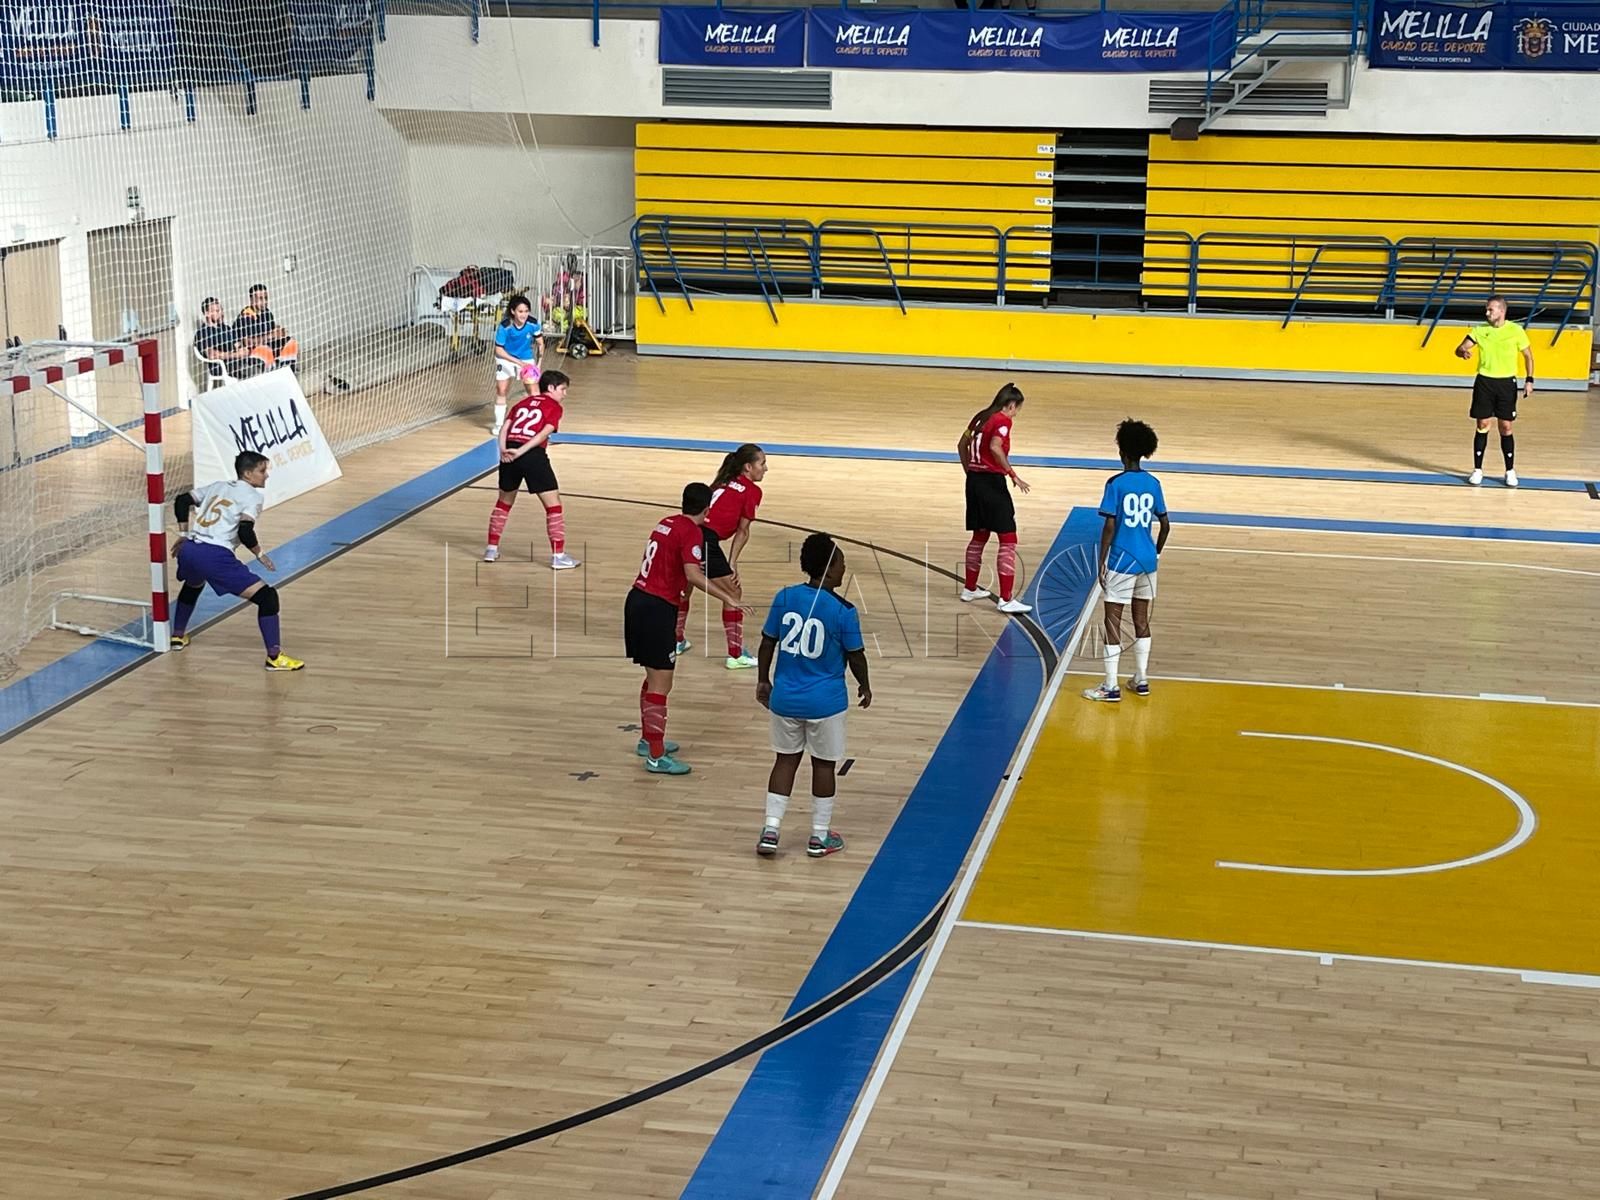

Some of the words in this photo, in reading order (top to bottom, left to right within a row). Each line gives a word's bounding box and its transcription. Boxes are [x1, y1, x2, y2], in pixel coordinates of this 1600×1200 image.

[705, 23, 777, 44] MELILLA
[836, 24, 910, 46] MELILLA
[968, 26, 1043, 48] MELILLA
[1102, 27, 1179, 48] MELILLA
[1380, 9, 1493, 41] MELILLA
[1562, 22, 1600, 32] CIUDAD
[1380, 40, 1418, 52] CIUDAD
[1420, 41, 1440, 53] DEL
[1444, 42, 1487, 54] DEPORTE
[229, 398, 308, 453] MELILLA
[511, 407, 543, 436] 22
[197, 495, 233, 528] 15
[1122, 493, 1154, 528] 98
[780, 611, 825, 660] 20
